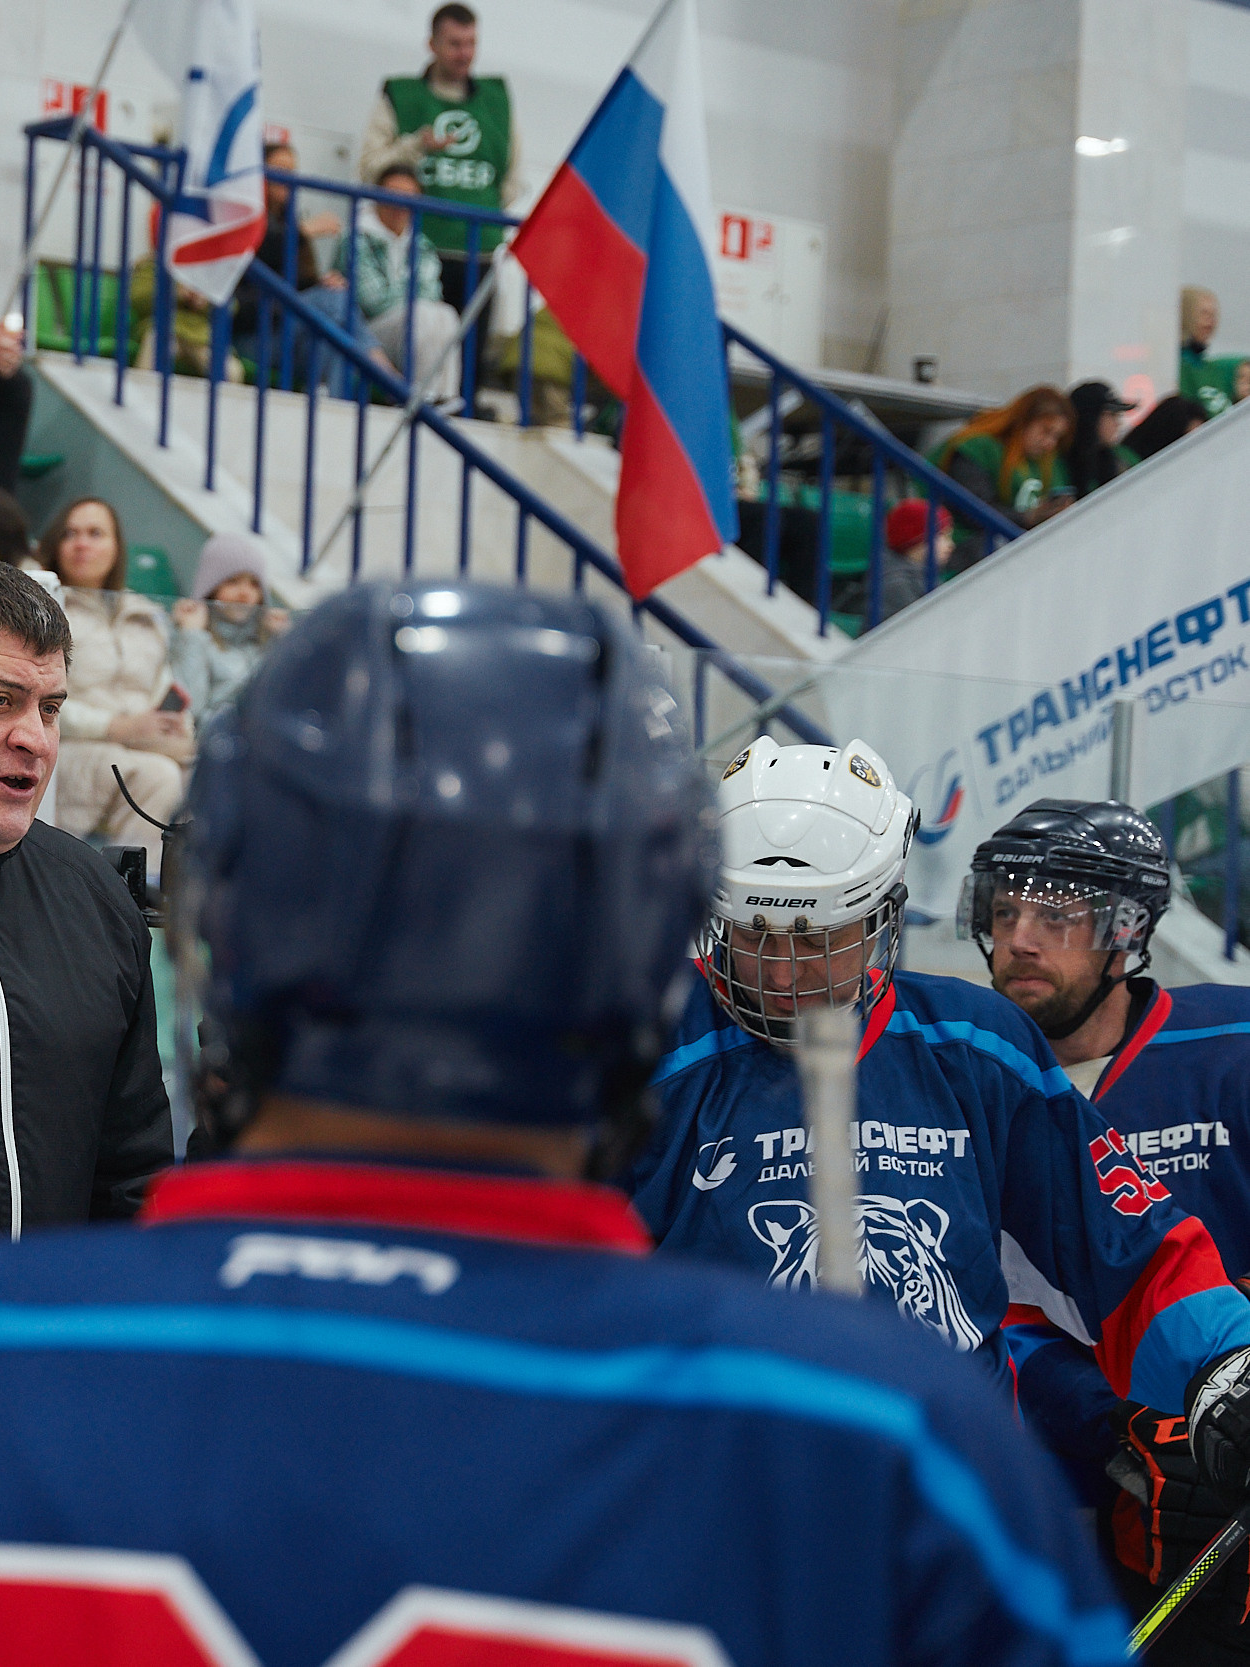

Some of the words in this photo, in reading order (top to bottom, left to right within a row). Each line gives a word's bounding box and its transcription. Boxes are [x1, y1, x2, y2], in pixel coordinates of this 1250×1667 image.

[991, 853, 1045, 865] BAUER
[1142, 874, 1168, 888] BAUER
[745, 895, 817, 909] BAUER
[753, 1120, 970, 1160] ТРСНЕФТ
